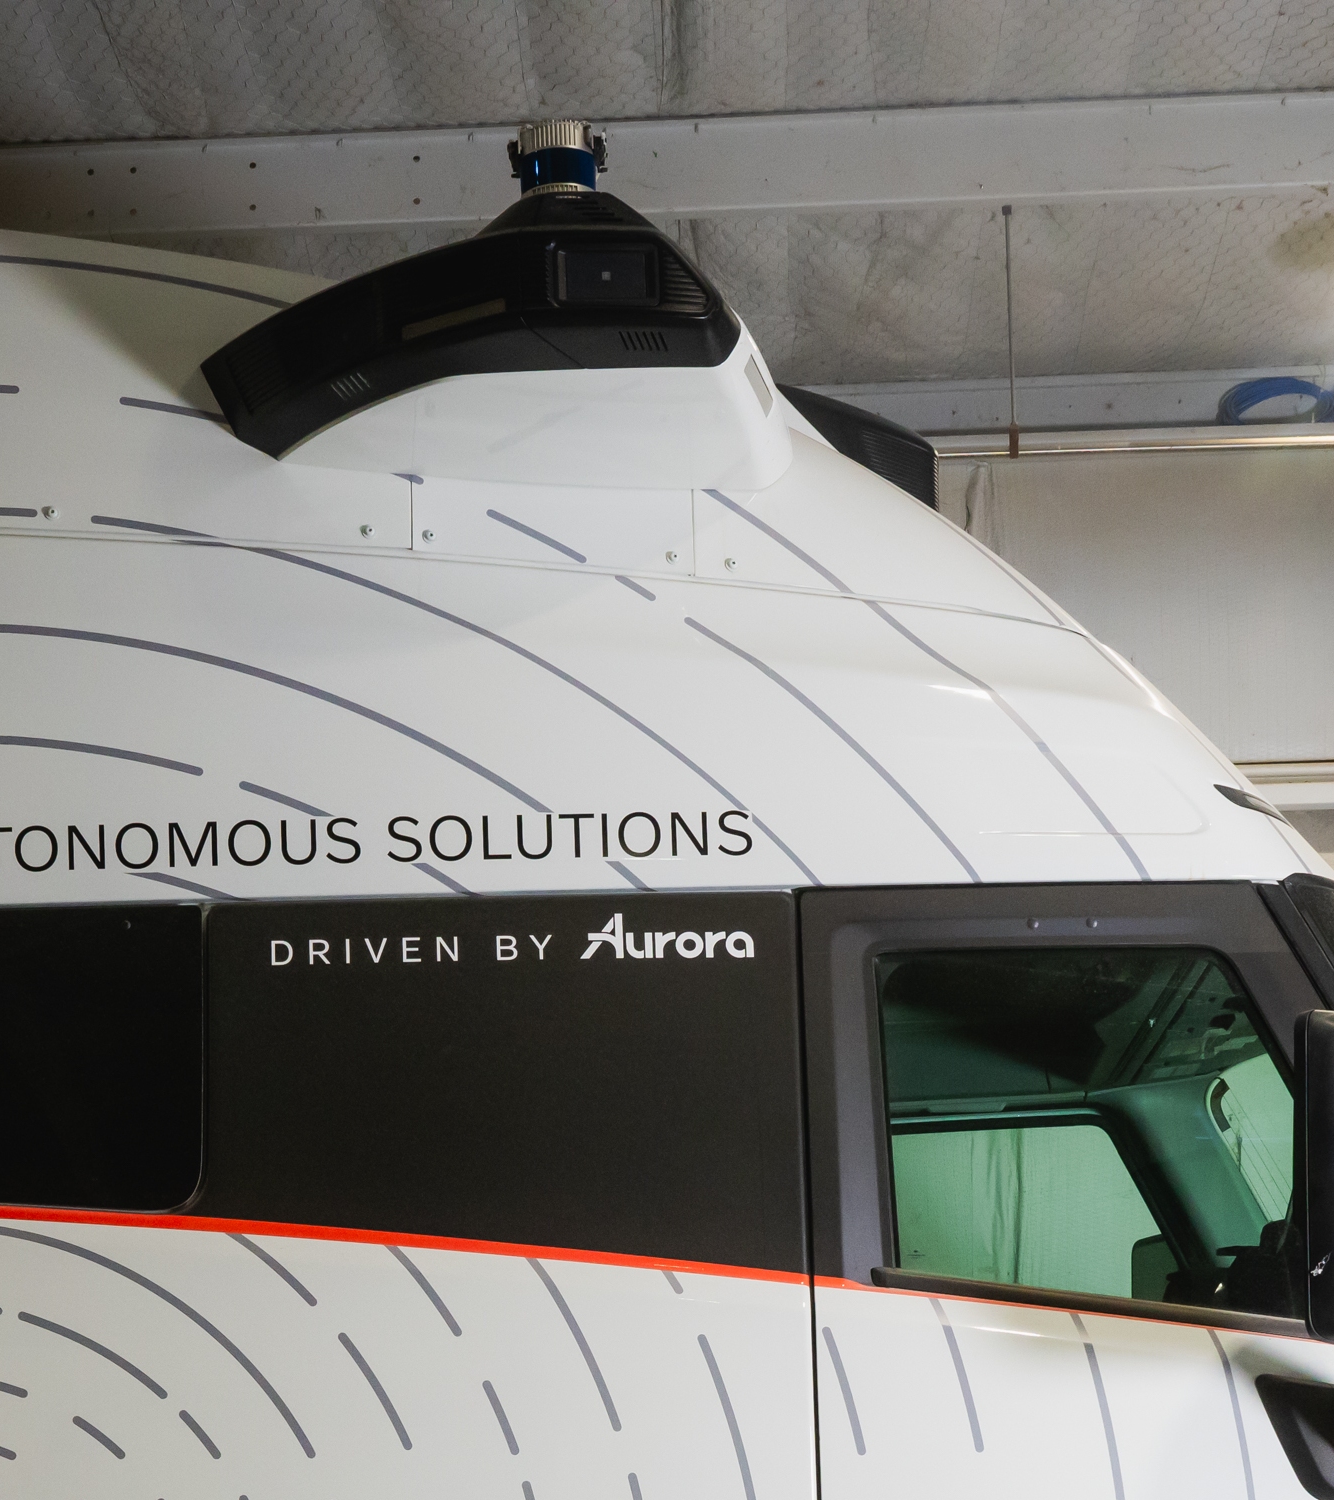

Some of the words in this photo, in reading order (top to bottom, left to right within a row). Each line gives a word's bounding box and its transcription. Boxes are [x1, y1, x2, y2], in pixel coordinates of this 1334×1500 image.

[386, 809, 753, 864] SOLUTIONS
[270, 932, 462, 967] DRIVEN
[497, 932, 554, 962] BY
[580, 911, 755, 961] Aurora
